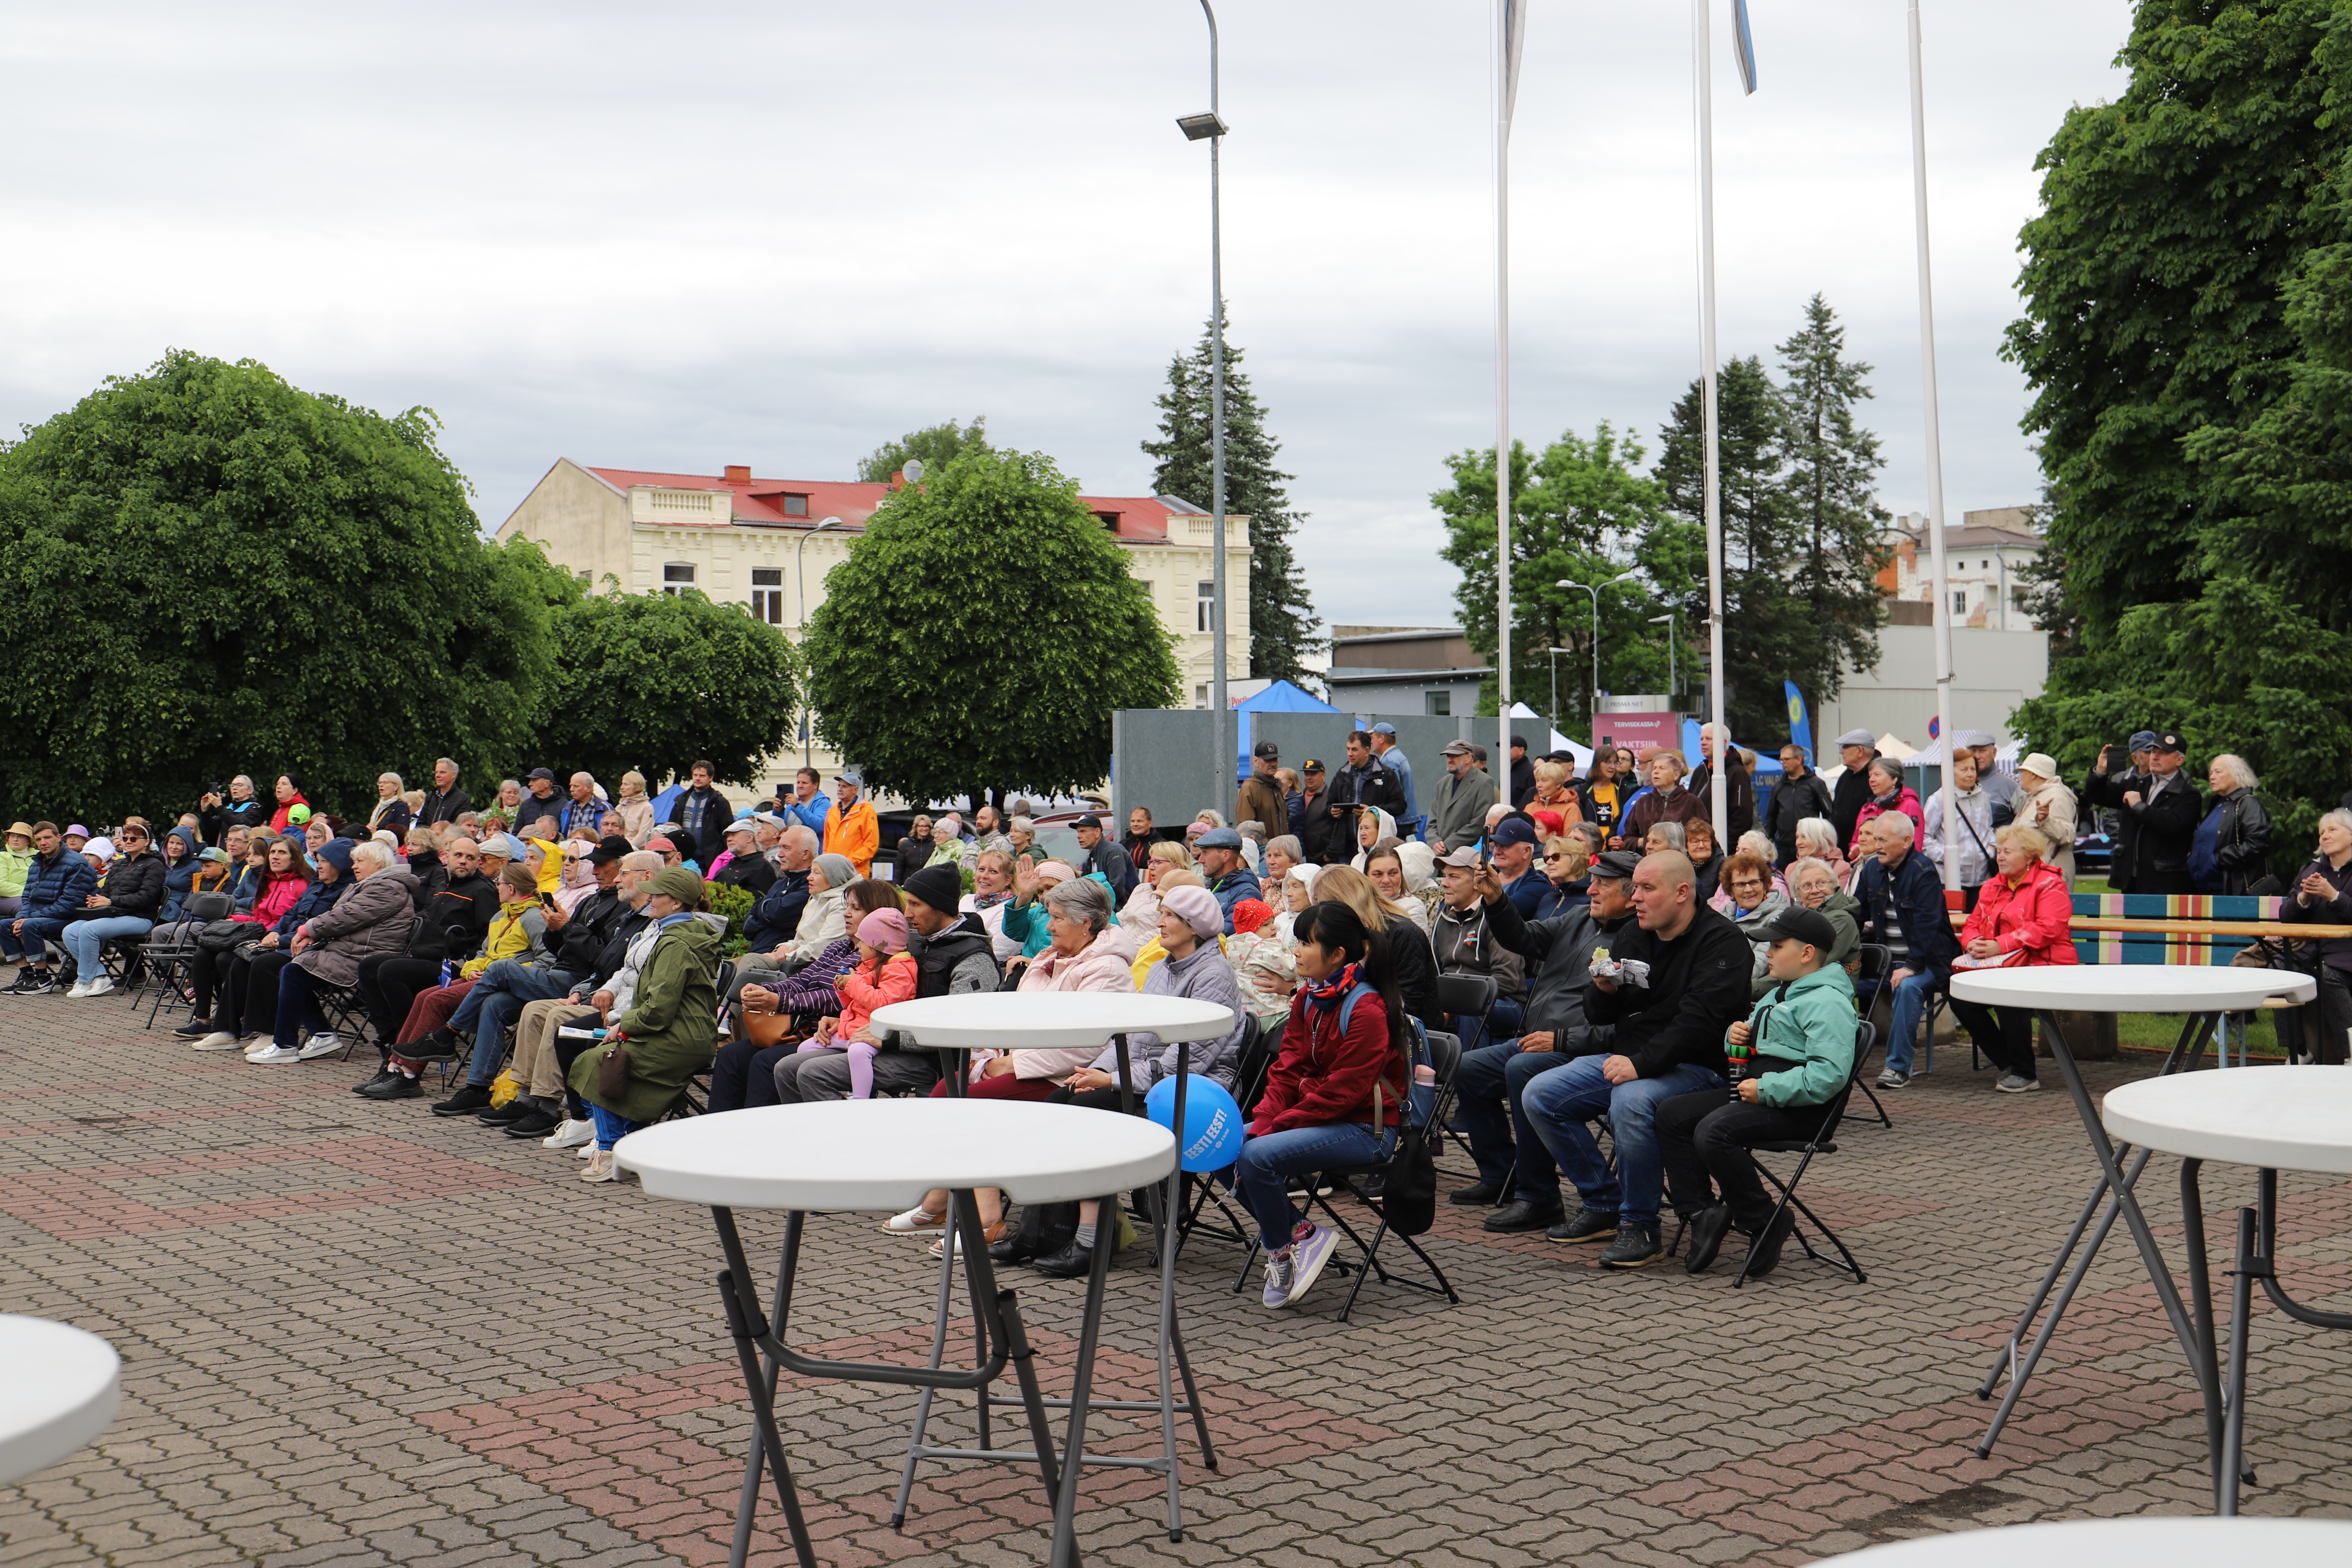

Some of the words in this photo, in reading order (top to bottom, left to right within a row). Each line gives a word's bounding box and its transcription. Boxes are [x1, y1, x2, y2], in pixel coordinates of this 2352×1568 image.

[1305, 760, 1314, 769] P
[1756, 775, 1763, 786] LC
[1183, 1135, 1213, 1160] EESTI
[1205, 1107, 1227, 1139] EEST!
[1220, 1127, 1230, 1141] EKRE
